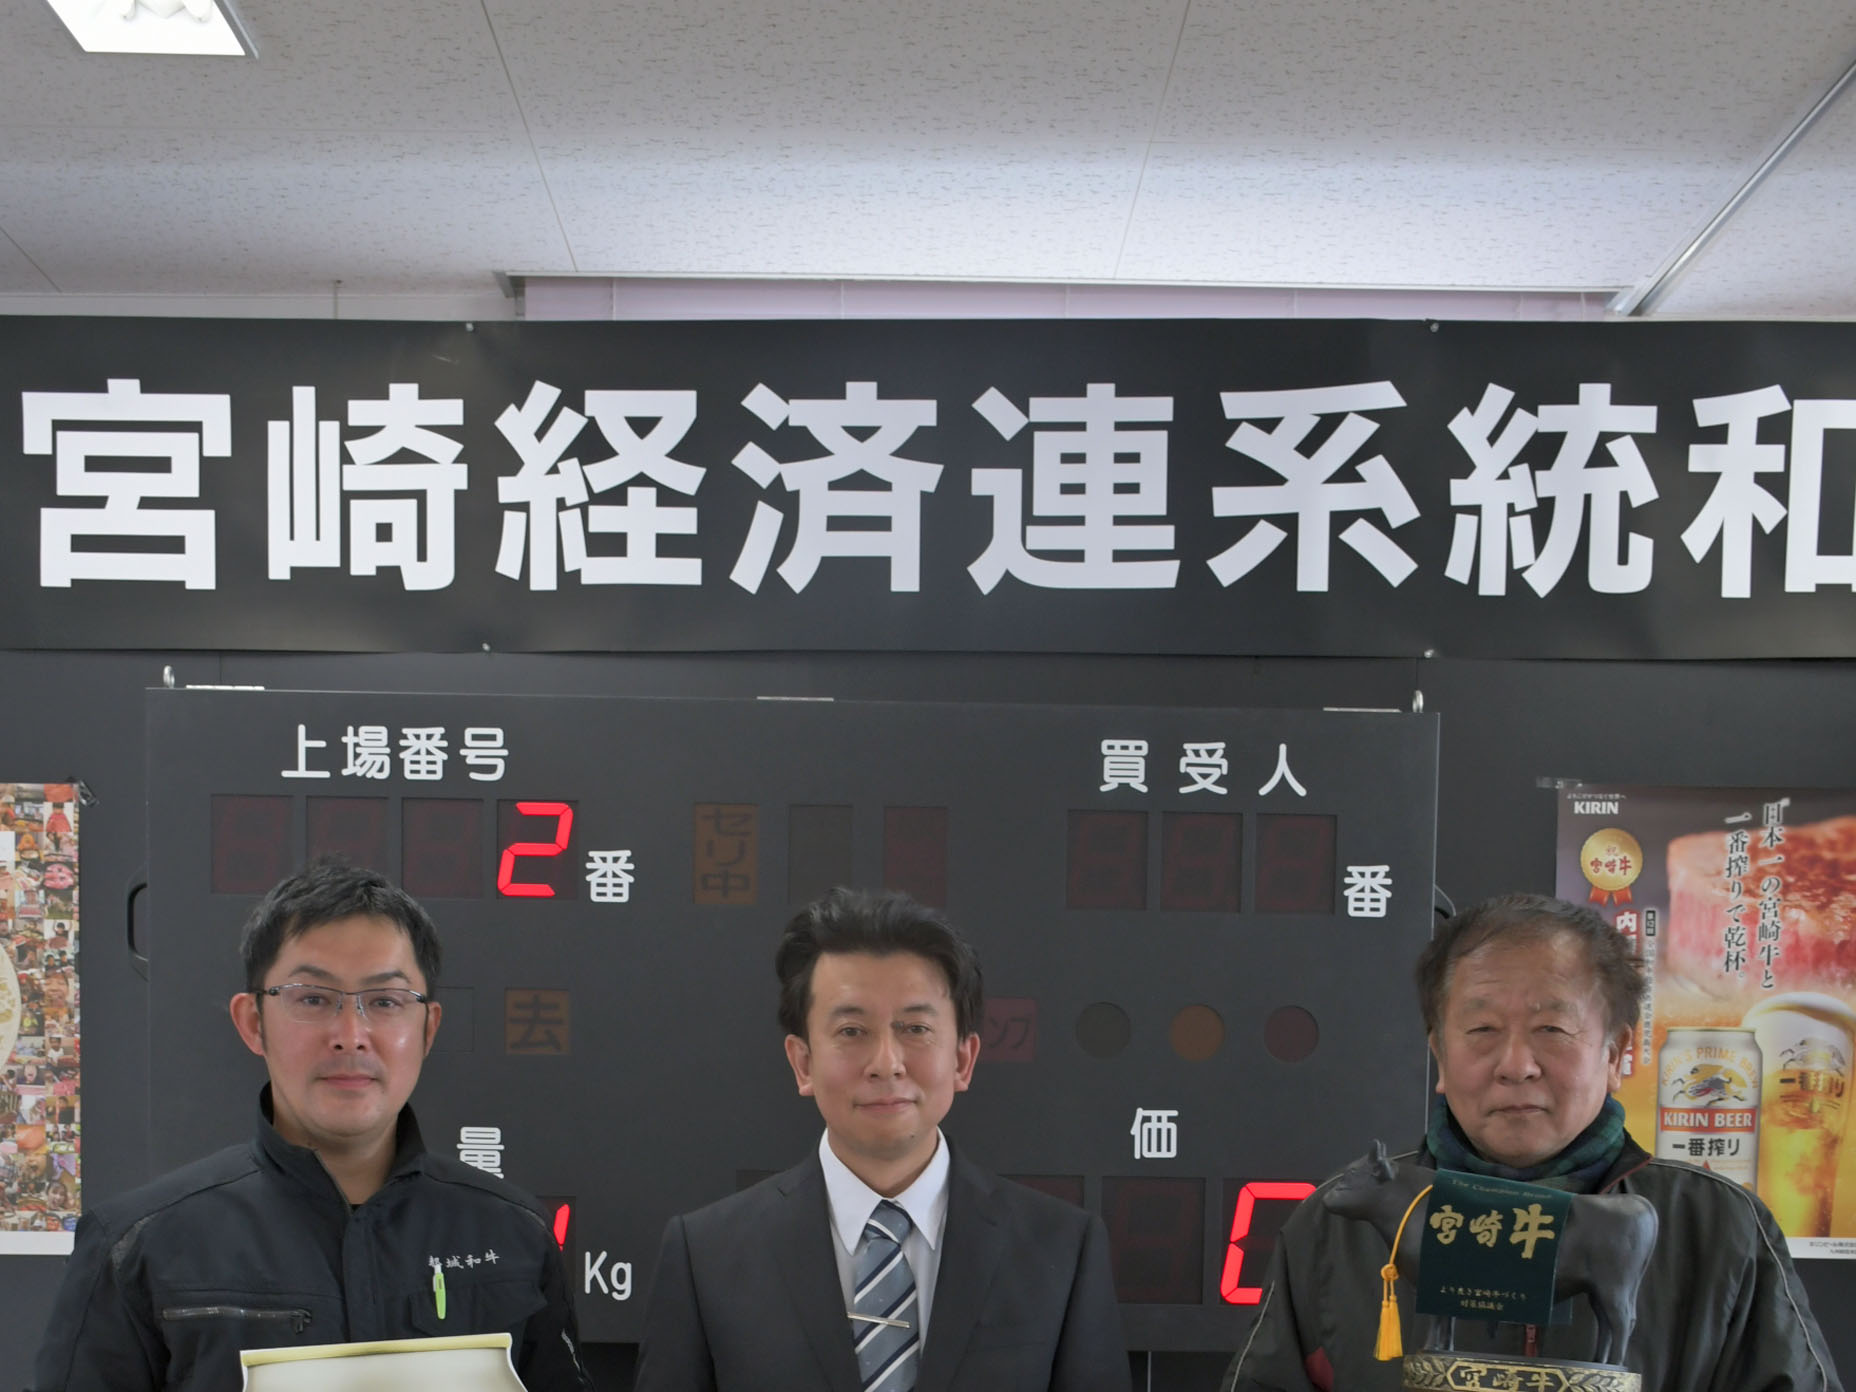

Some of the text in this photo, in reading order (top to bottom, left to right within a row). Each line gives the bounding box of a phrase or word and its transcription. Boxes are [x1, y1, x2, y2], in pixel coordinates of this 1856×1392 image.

[22, 379, 1856, 599] 宮崎経済連系統和
[281, 724, 509, 782] 上場番号
[1099, 739, 1307, 797] 買受人
[1574, 801, 1619, 814] KIRIN
[496, 802, 574, 897] 2
[585, 849, 635, 903] 番
[700, 806, 752, 898] セリ中
[1344, 865, 1393, 918] 番
[1758, 803, 1785, 989] 日本一の宮崎牛と
[507, 995, 562, 1053] 去
[1130, 1107, 1179, 1159] 価
[1664, 1112, 1753, 1127] KIRIN BEER
[1672, 1138, 1740, 1157] 一番搾り
[1430, 1203, 1555, 1259] 宮崎牛
[583, 1250, 633, 1301] Kg
